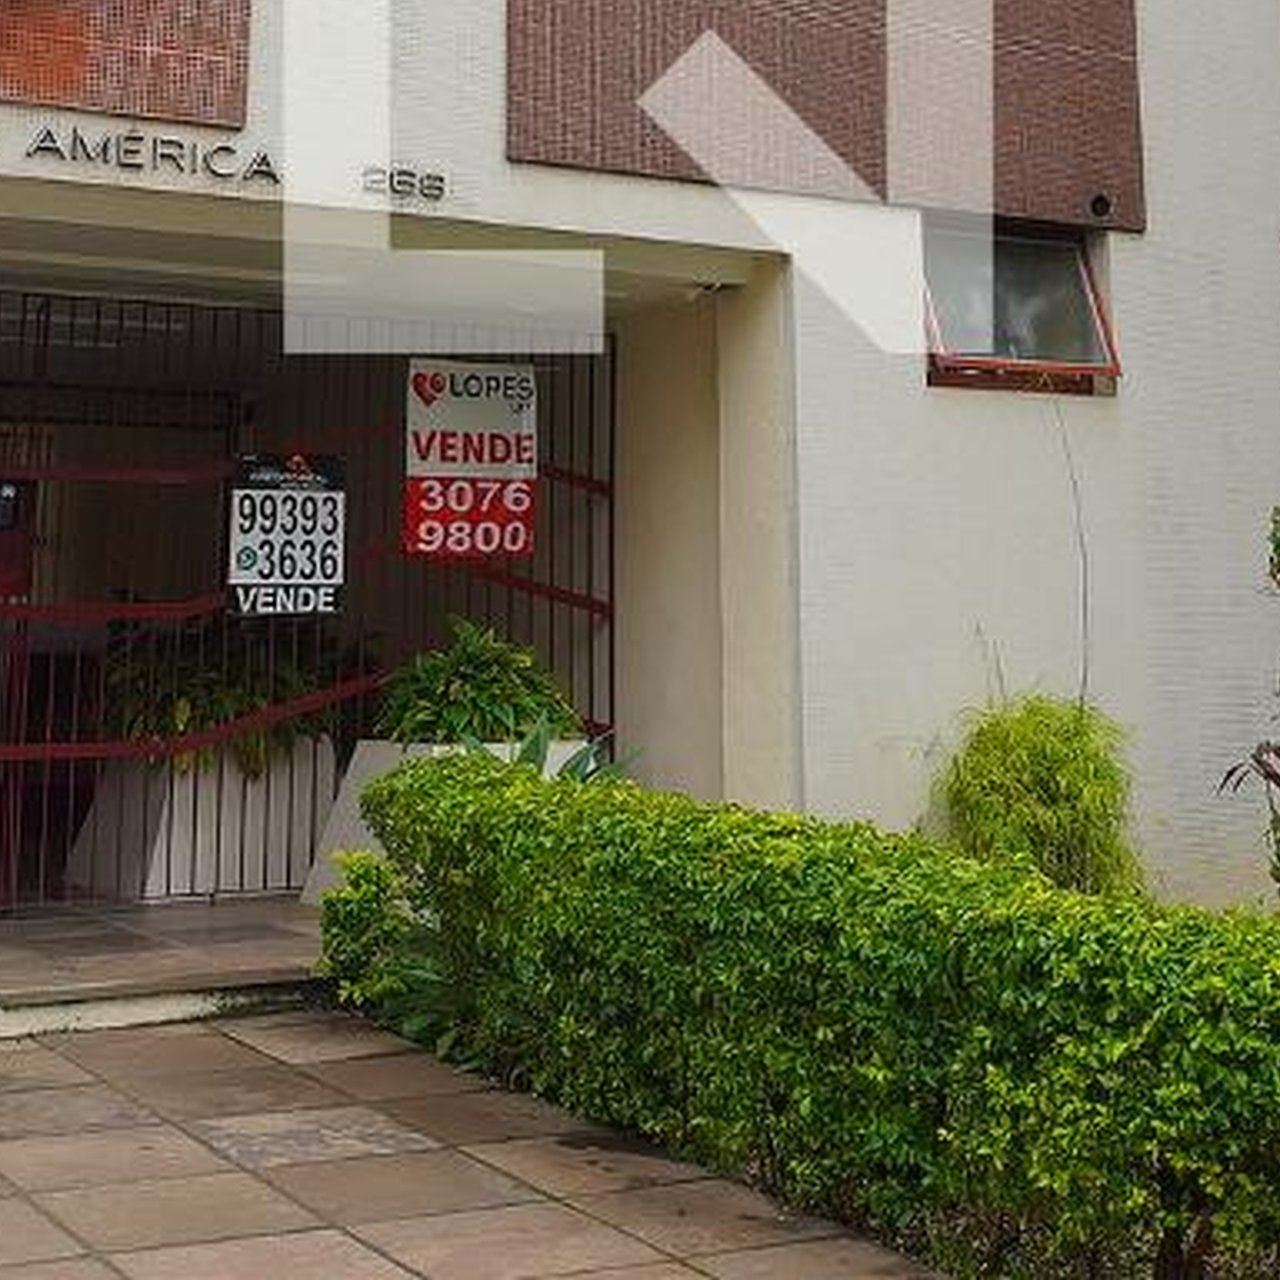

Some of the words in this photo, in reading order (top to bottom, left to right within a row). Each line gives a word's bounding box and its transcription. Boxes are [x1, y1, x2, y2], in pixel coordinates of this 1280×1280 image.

[26, 123, 282, 185] AMÉRICA
[449, 373, 534, 401] LOPES
[412, 430, 534, 464] VENDE
[420, 480, 531, 512] 3076
[239, 493, 339, 536] 99393
[418, 520, 526, 552] 9800
[258, 540, 338, 580] 3636
[236, 586, 336, 614] VENDE
